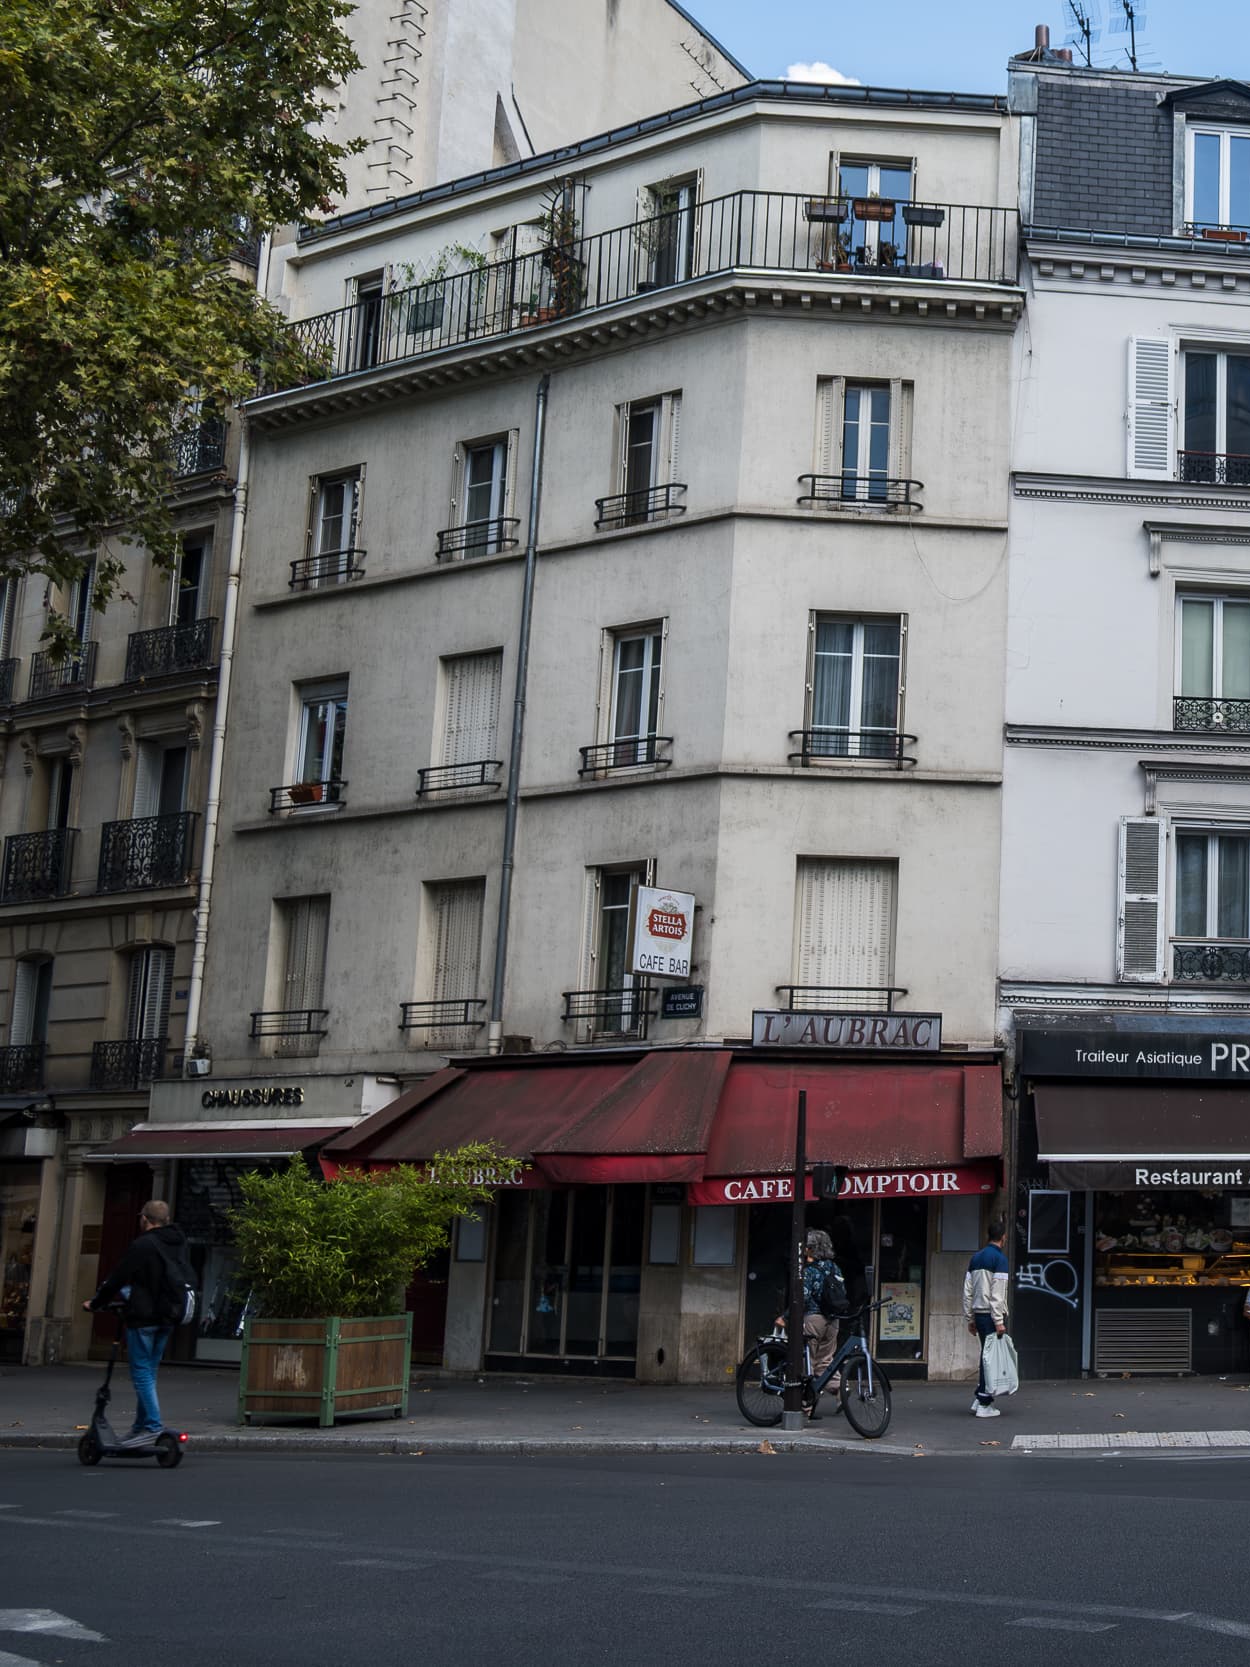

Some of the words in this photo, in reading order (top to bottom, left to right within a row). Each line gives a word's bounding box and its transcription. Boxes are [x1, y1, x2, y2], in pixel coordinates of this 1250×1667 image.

[653, 914, 682, 926] STELLA
[652, 923, 683, 936] ARTOIS
[640, 954, 664, 971] CAFE
[669, 958, 688, 974] BAR
[666, 1003, 675, 1011] DE
[675, 1002, 697, 1010] CLICHY
[1076, 1049, 1130, 1063] Traiteur
[1136, 1051, 1202, 1067] Asiatique
[202, 1087, 304, 1108] CHAUSSURES
[1135, 1169, 1243, 1185] Restaurant
[724, 1179, 792, 1200] CAFE
[838, 1173, 960, 1195] OMPTOIR
